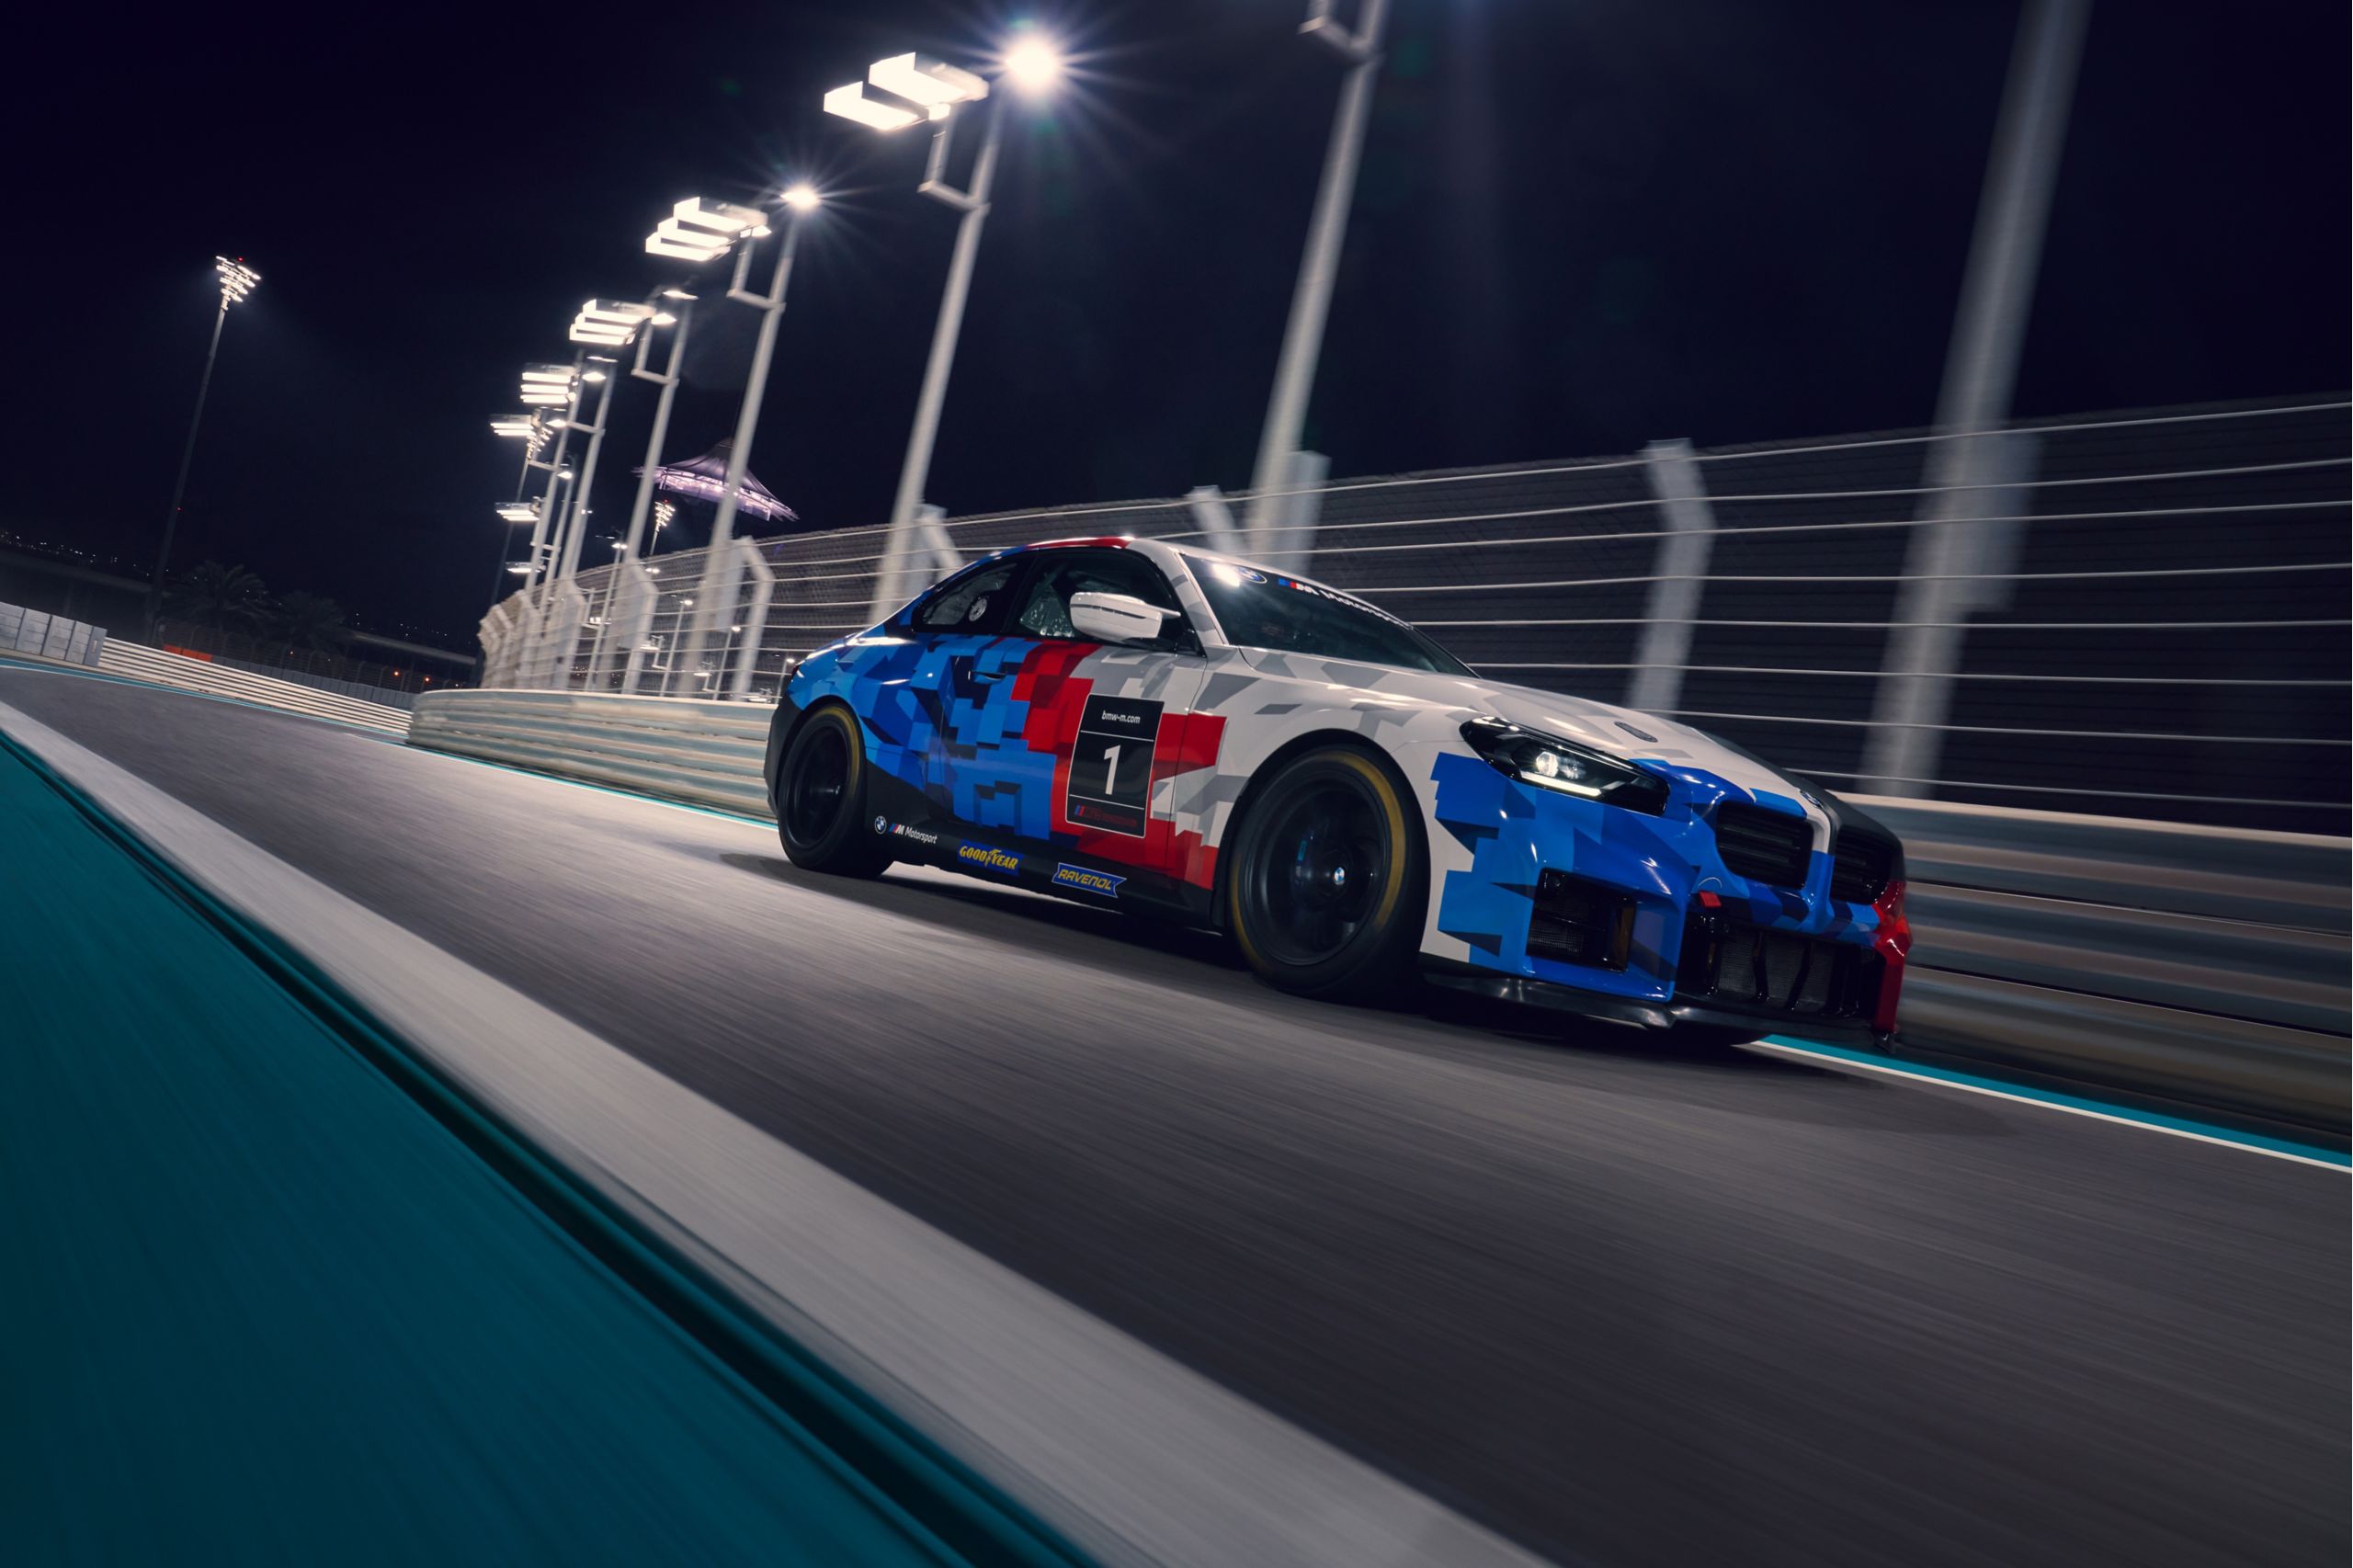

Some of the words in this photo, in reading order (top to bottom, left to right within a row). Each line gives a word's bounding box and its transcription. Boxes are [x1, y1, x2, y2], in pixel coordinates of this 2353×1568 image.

[1101, 710, 1141, 724] bmw-m.com
[1103, 744, 1121, 795] 1
[905, 826, 938, 844] Motorsport
[959, 845, 1018, 870] GOODYEAR
[1058, 869, 1112, 891] RAVENOL
